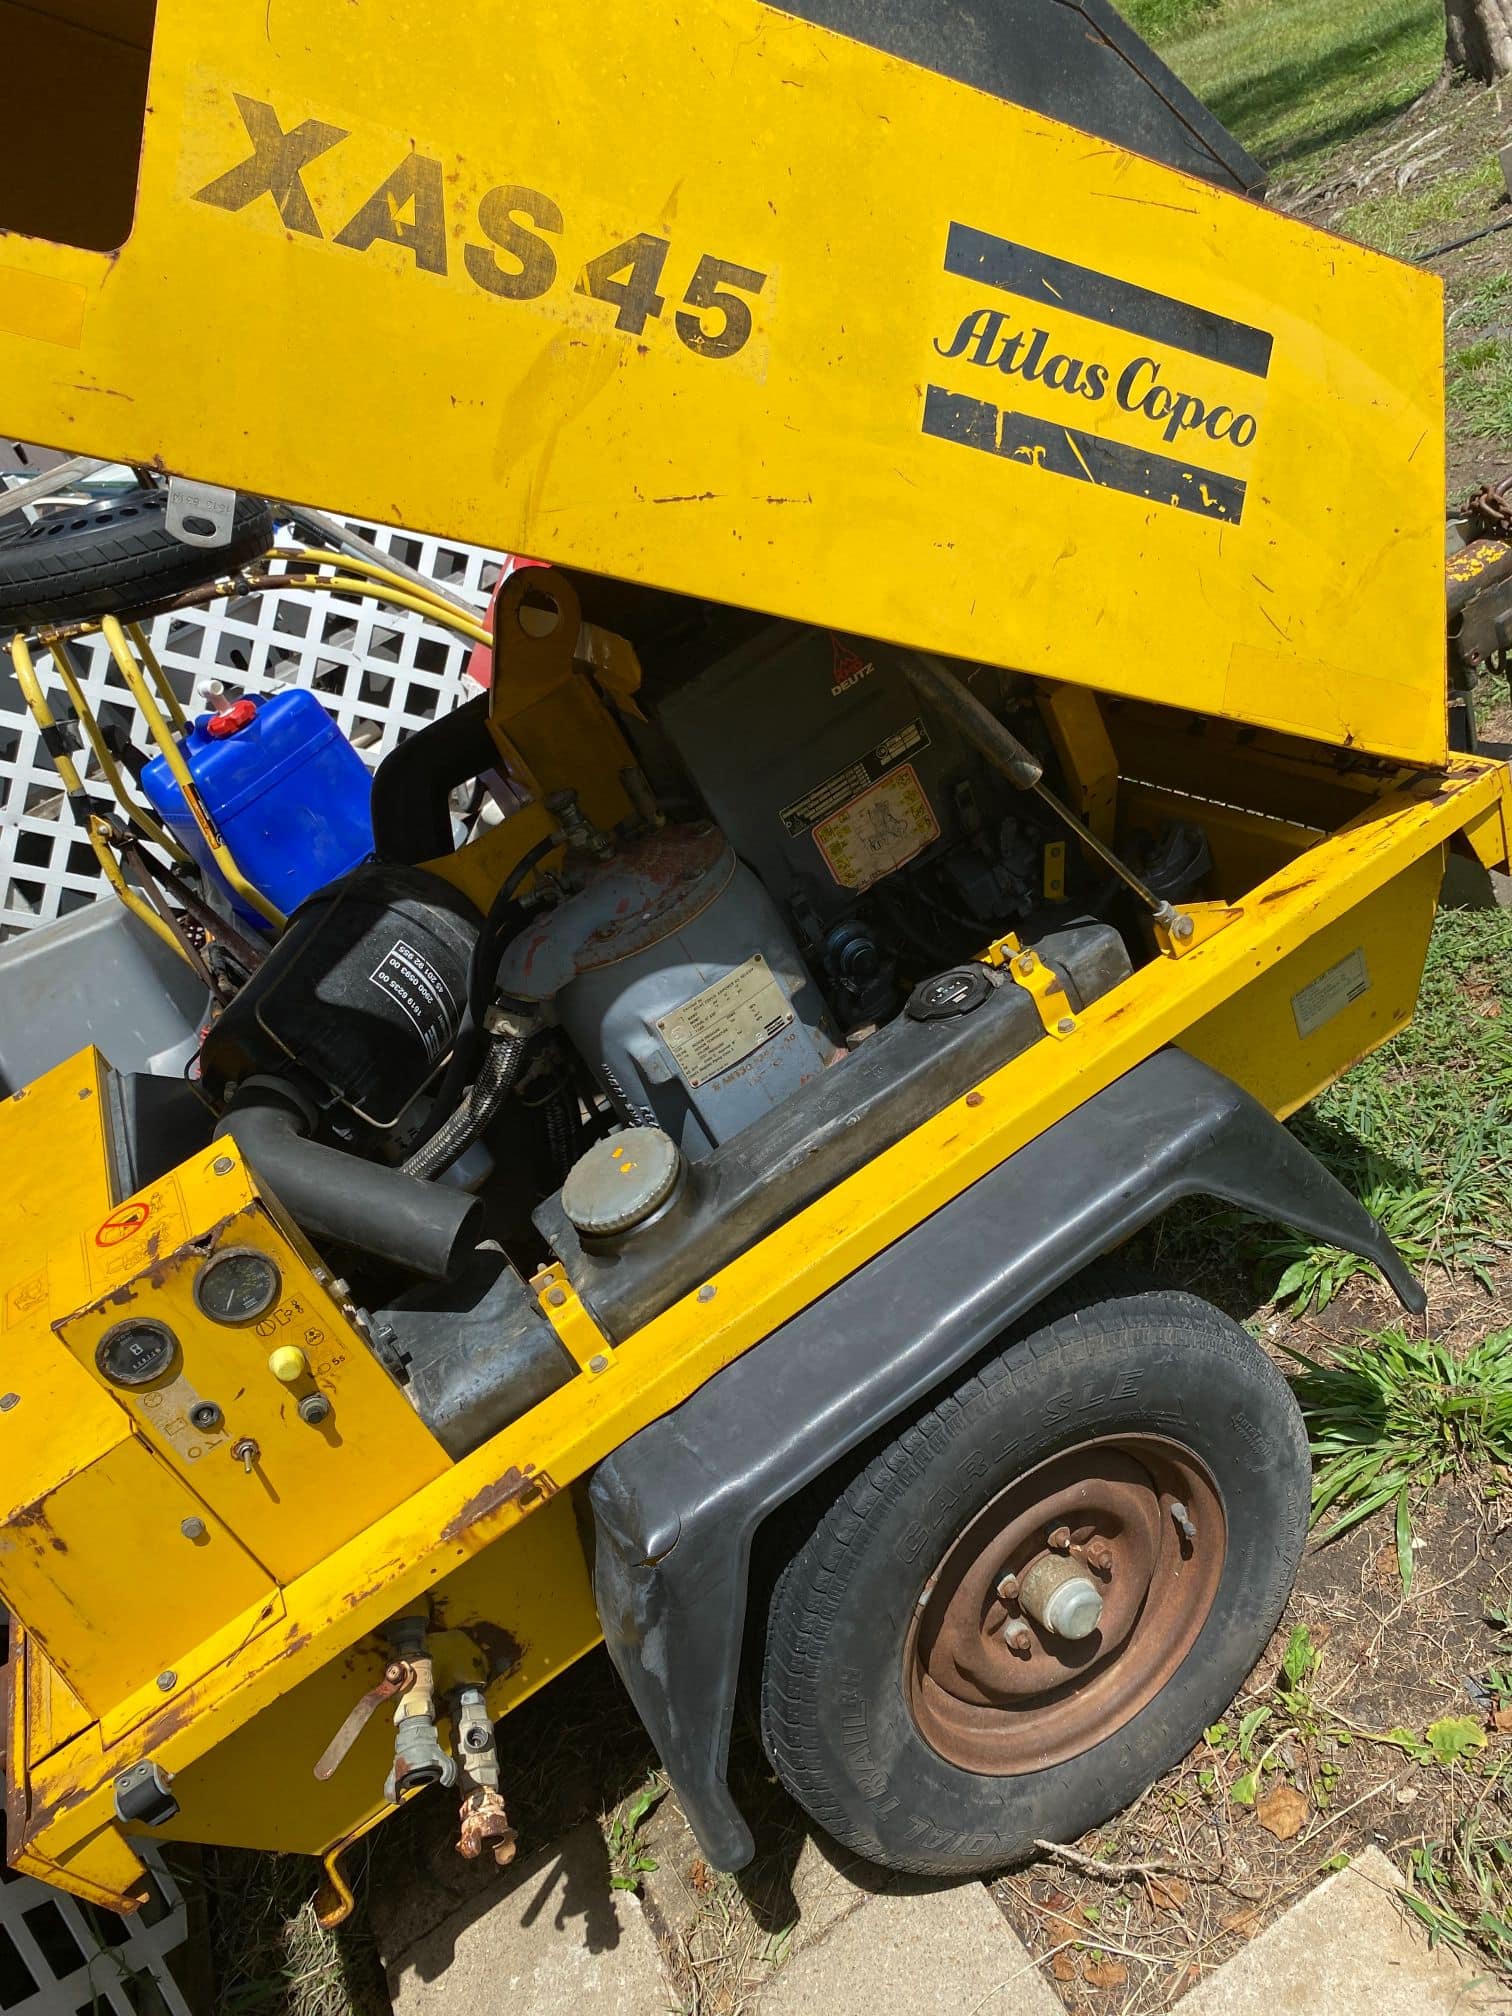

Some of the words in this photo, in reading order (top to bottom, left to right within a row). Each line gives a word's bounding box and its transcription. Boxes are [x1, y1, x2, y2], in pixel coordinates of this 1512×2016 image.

[189, 92, 767, 358] XAS45
[933, 309, 1109, 400] Atlas
[1116, 357, 1257, 447] Copco
[831, 662, 875, 697] DEUTZ
[379, 971, 390, 982] 00
[389, 959, 401, 969] 00
[390, 980, 408, 999] 6235
